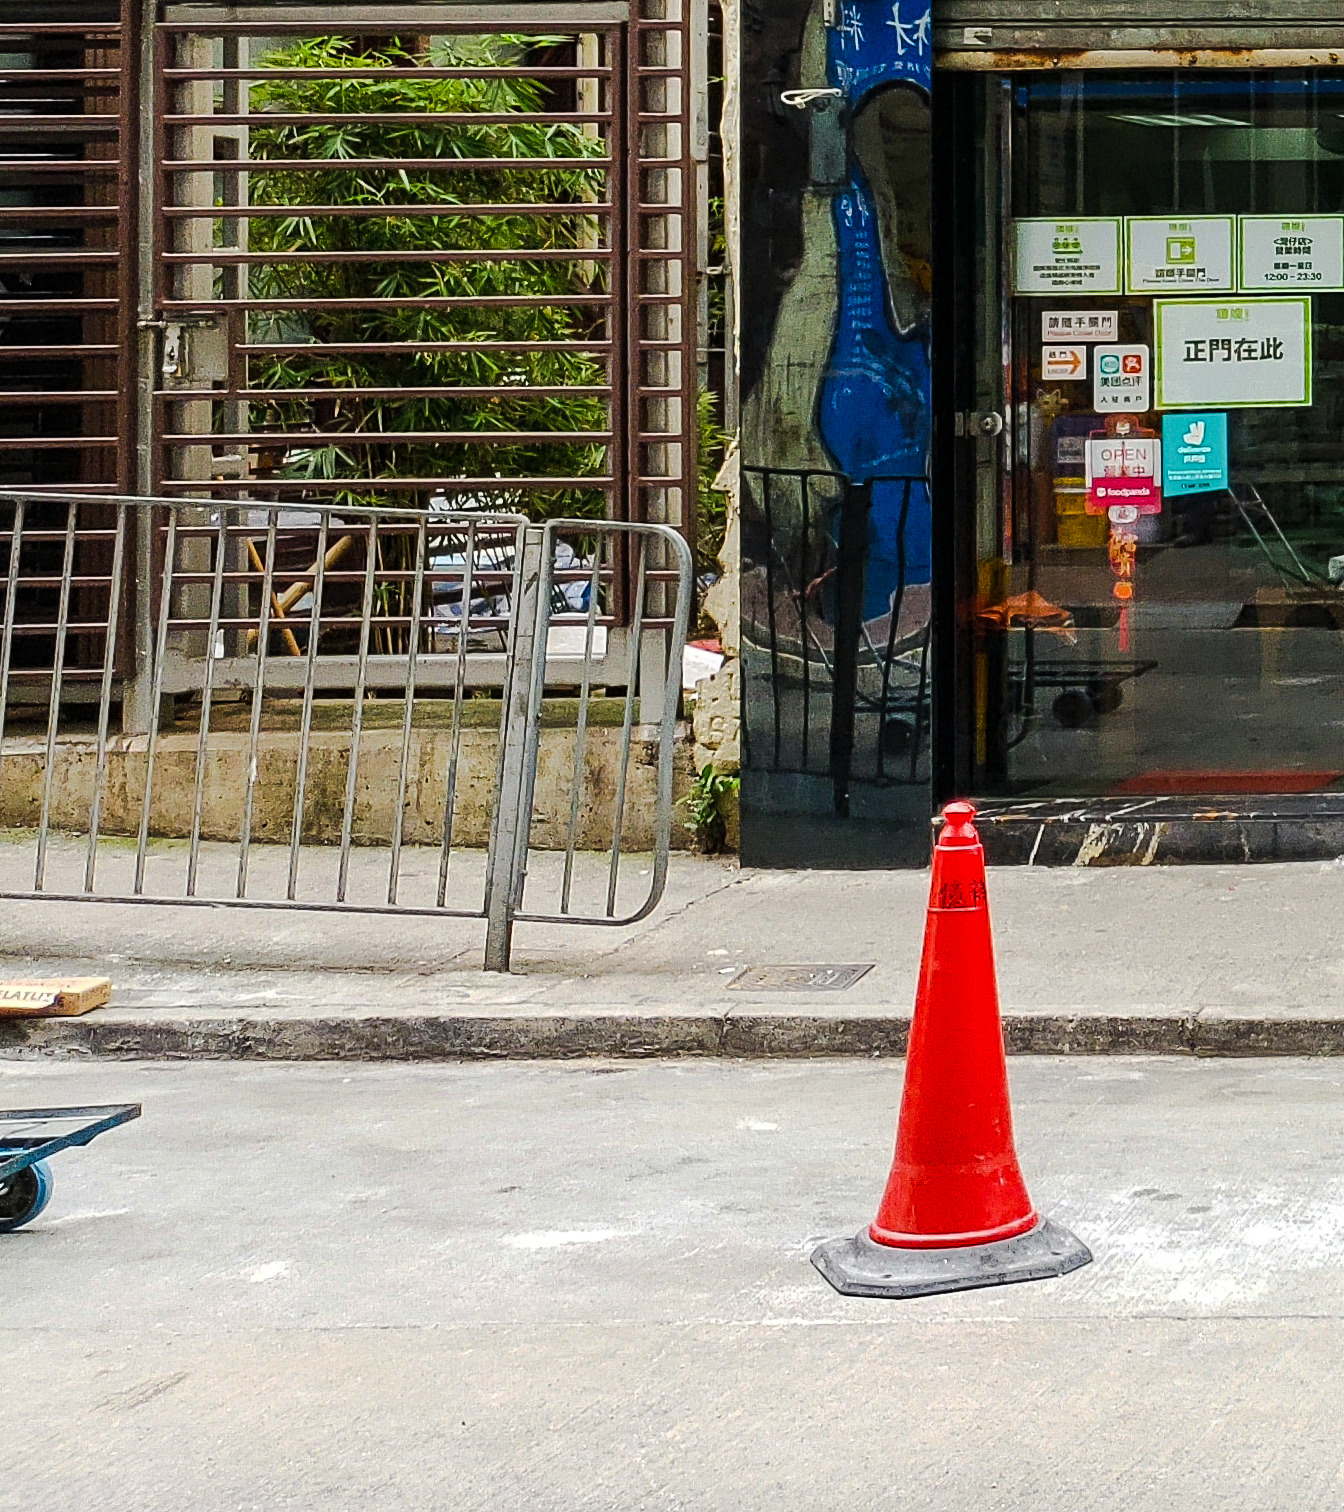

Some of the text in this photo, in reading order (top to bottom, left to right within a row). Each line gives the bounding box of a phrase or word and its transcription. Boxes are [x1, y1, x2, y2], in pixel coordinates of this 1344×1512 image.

[1183, 336, 1285, 363] 正門在此
[1101, 448, 1147, 462] OPEN
